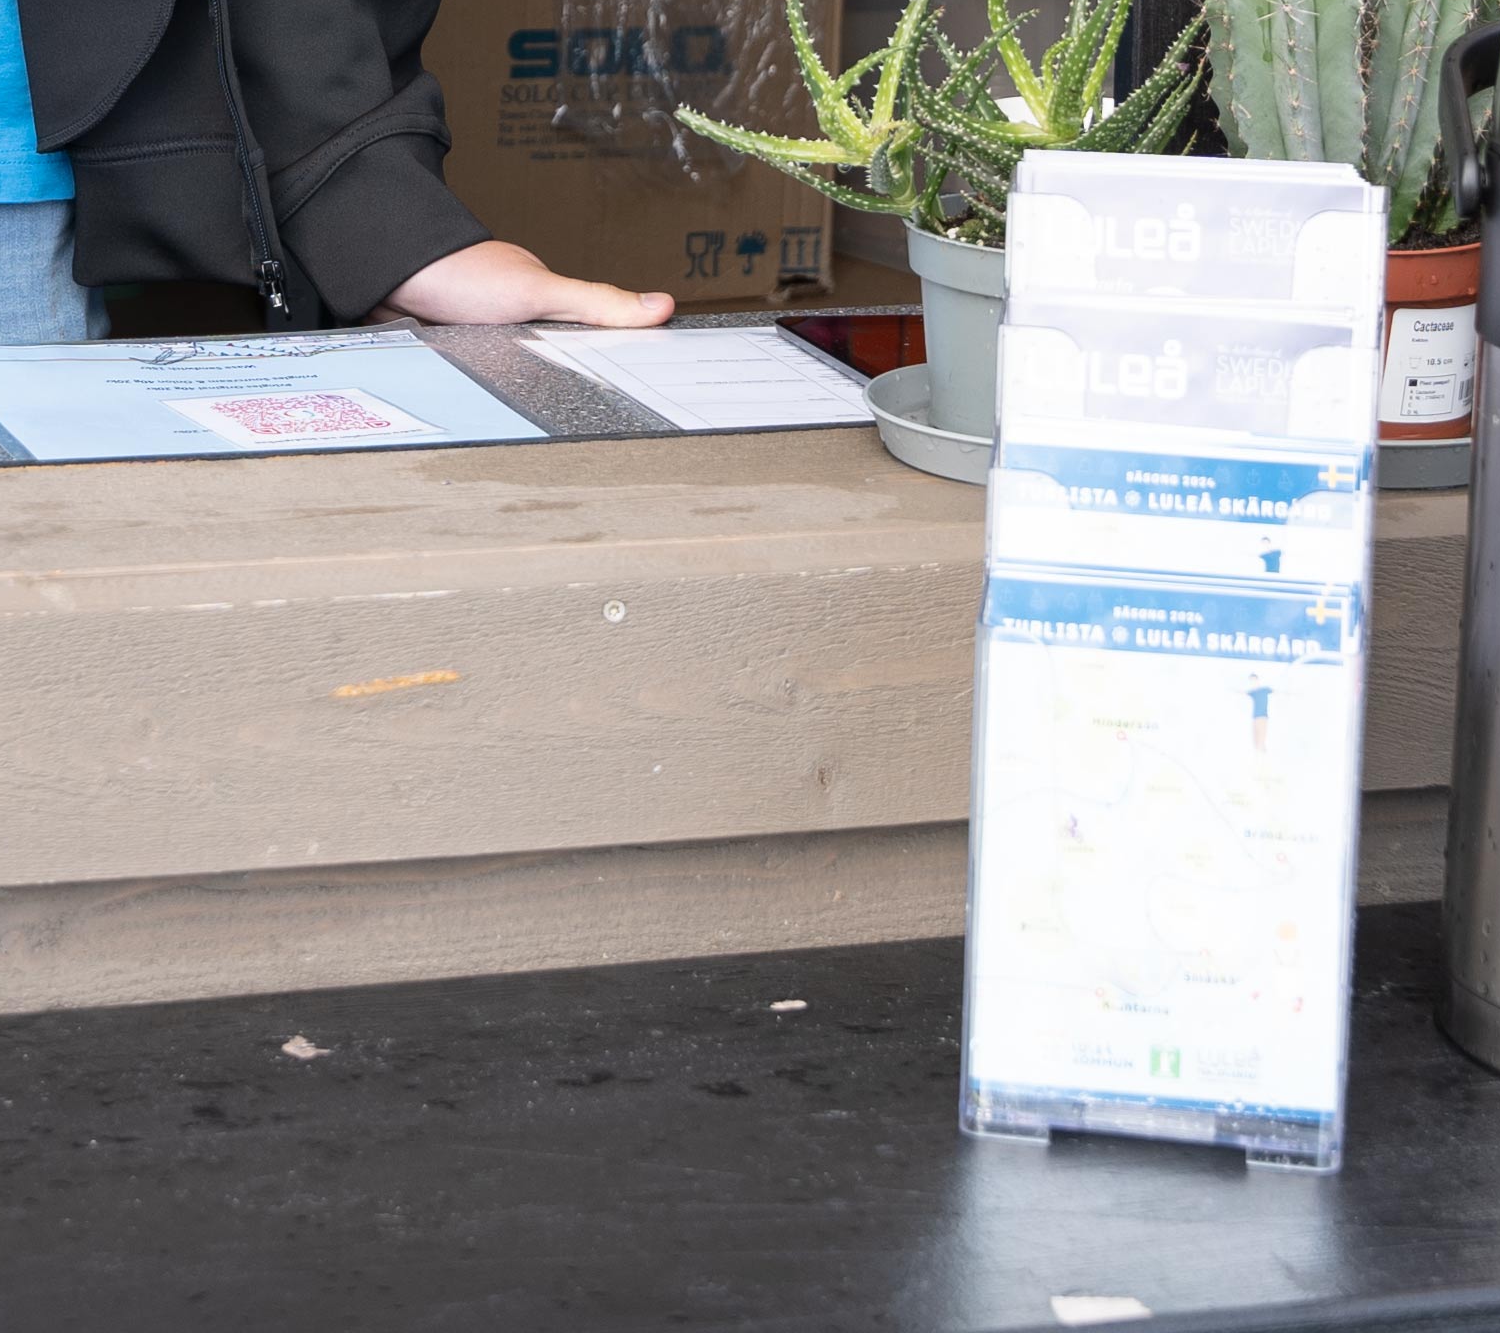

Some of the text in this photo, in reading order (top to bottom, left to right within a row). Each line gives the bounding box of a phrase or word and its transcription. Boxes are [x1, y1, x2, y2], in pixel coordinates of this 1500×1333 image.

[1413, 319, 1455, 332] Cactaceae
[1125, 469, 1217, 490] SÄSONG 2024
[1148, 490, 1213, 514] LULEÅ
[1217, 494, 1333, 521] SKÄRGÅRD
[1112, 605, 1204, 625] SÄSONG 2024
[1002, 616, 1321, 658] TURLISTA LULEÅ SKÄRGÅRD
